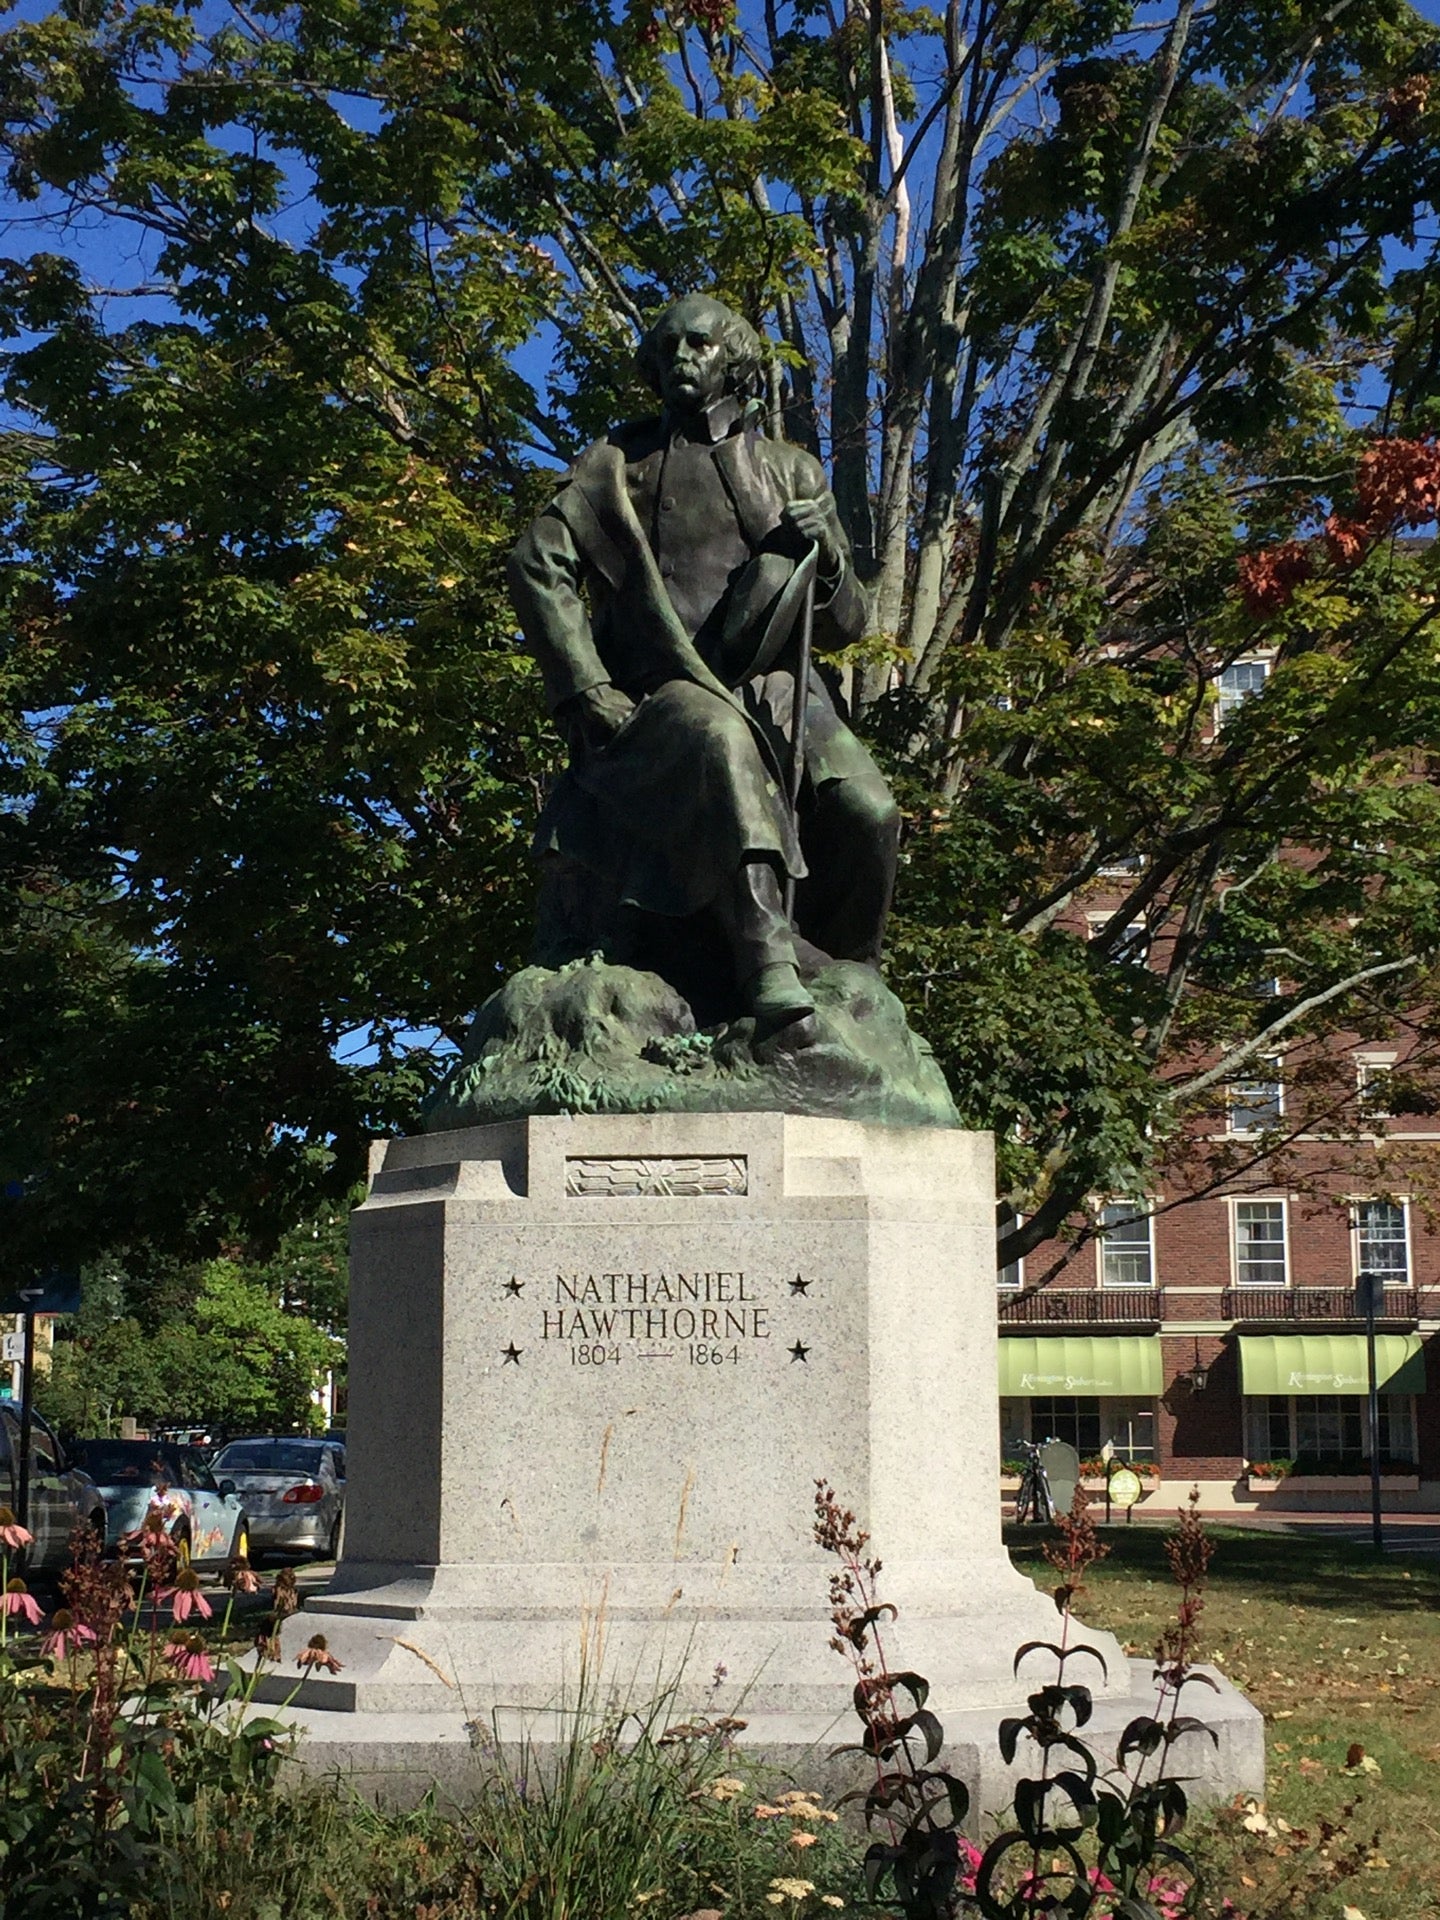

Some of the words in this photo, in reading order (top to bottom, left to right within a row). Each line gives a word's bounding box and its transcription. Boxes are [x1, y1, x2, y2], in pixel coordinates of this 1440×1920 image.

[555, 1272, 757, 1304] NATHANIEL
[539, 1308, 772, 1340] HAWTHORNE
[571, 1344, 622, 1366] 1804
[689, 1343, 741, 1366] 1864
